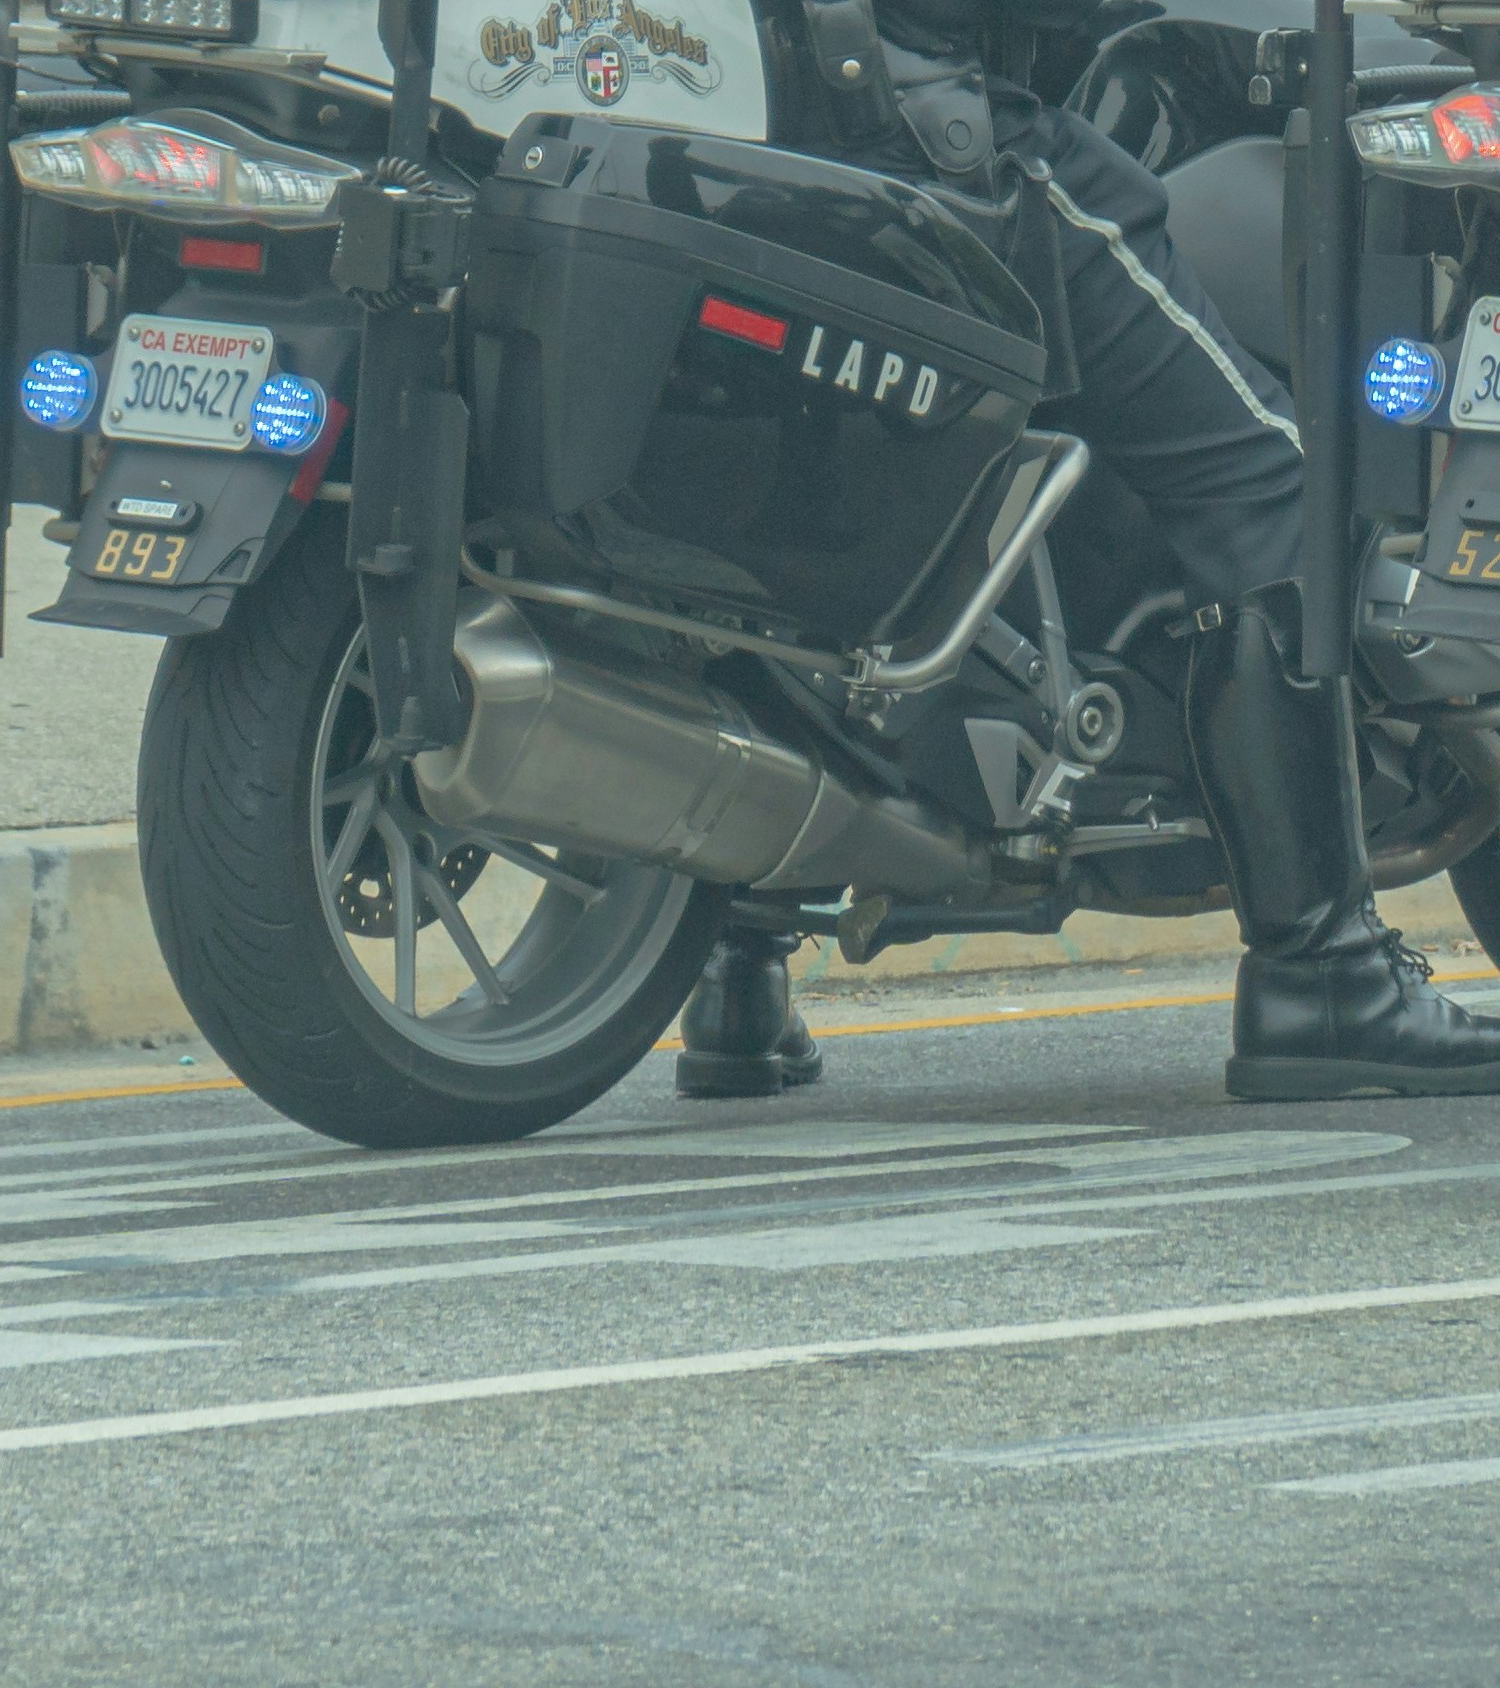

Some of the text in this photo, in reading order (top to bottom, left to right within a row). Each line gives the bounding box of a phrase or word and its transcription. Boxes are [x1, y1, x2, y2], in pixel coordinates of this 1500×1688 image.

[481, 18, 536, 67] City
[536, 2, 562, 49] of
[141, 329, 251, 359] CA EXEMPT
[802, 325, 938, 415] LAPD
[124, 360, 249, 418] 3005427
[96, 529, 186, 579] 893
